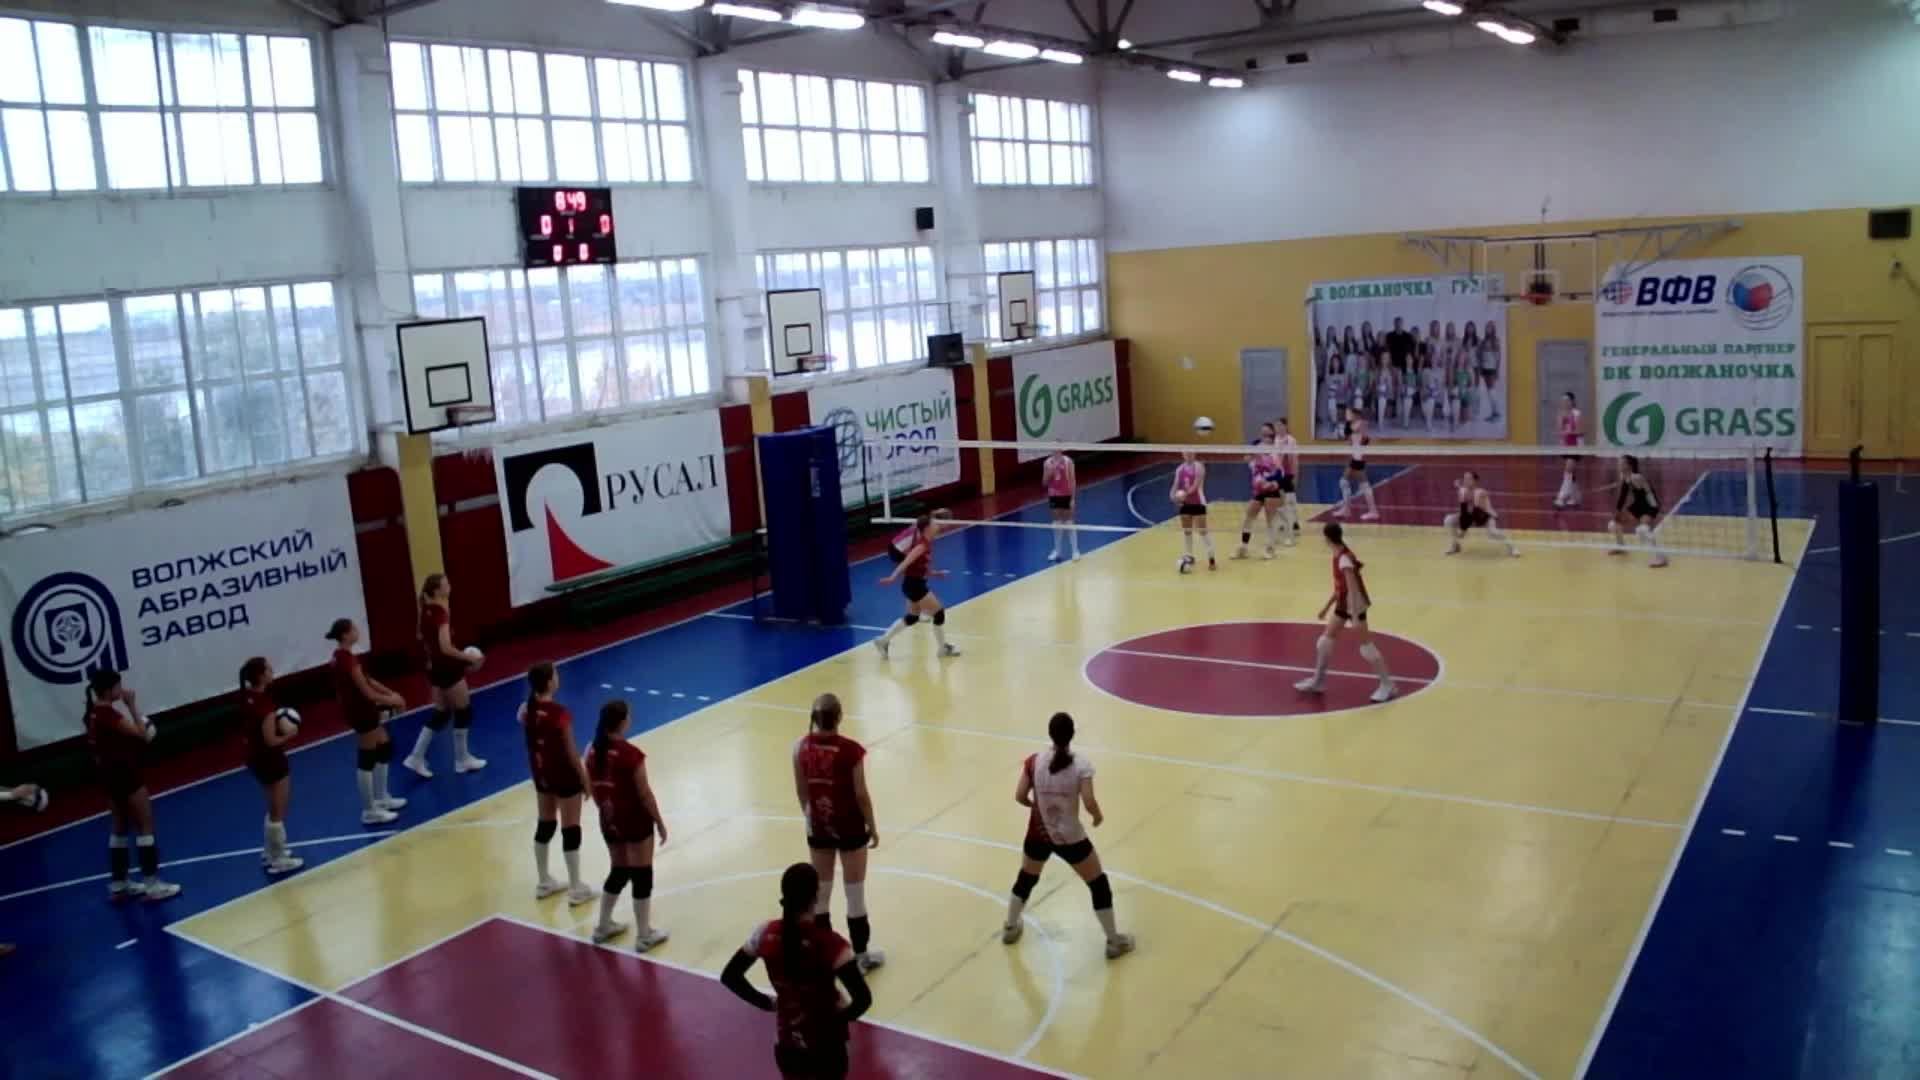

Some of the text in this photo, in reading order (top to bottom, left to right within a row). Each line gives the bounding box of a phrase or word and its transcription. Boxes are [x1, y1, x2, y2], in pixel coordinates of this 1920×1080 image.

[541, 214, 611, 235] 0 1 0
[1636, 275, 1717, 306] ВФВ
[1602, 344, 1717, 357] ГЕНЕРАЛЬНЫЙ
[1603, 363, 1796, 380] ВК ВОЛЖАНОЧКА
[864, 389, 952, 433] ЧИСТЫЙ
[1057, 375, 1114, 413] GRASS
[1675, 407, 1796, 437] GRASS
[605, 454, 719, 511] РУСАЛ
[132, 528, 314, 589] ВОЛЖСКИЙ
[138, 548, 348, 619] АБРАЗИВНЫЙ
[141, 603, 250, 647] ЗАВОД
